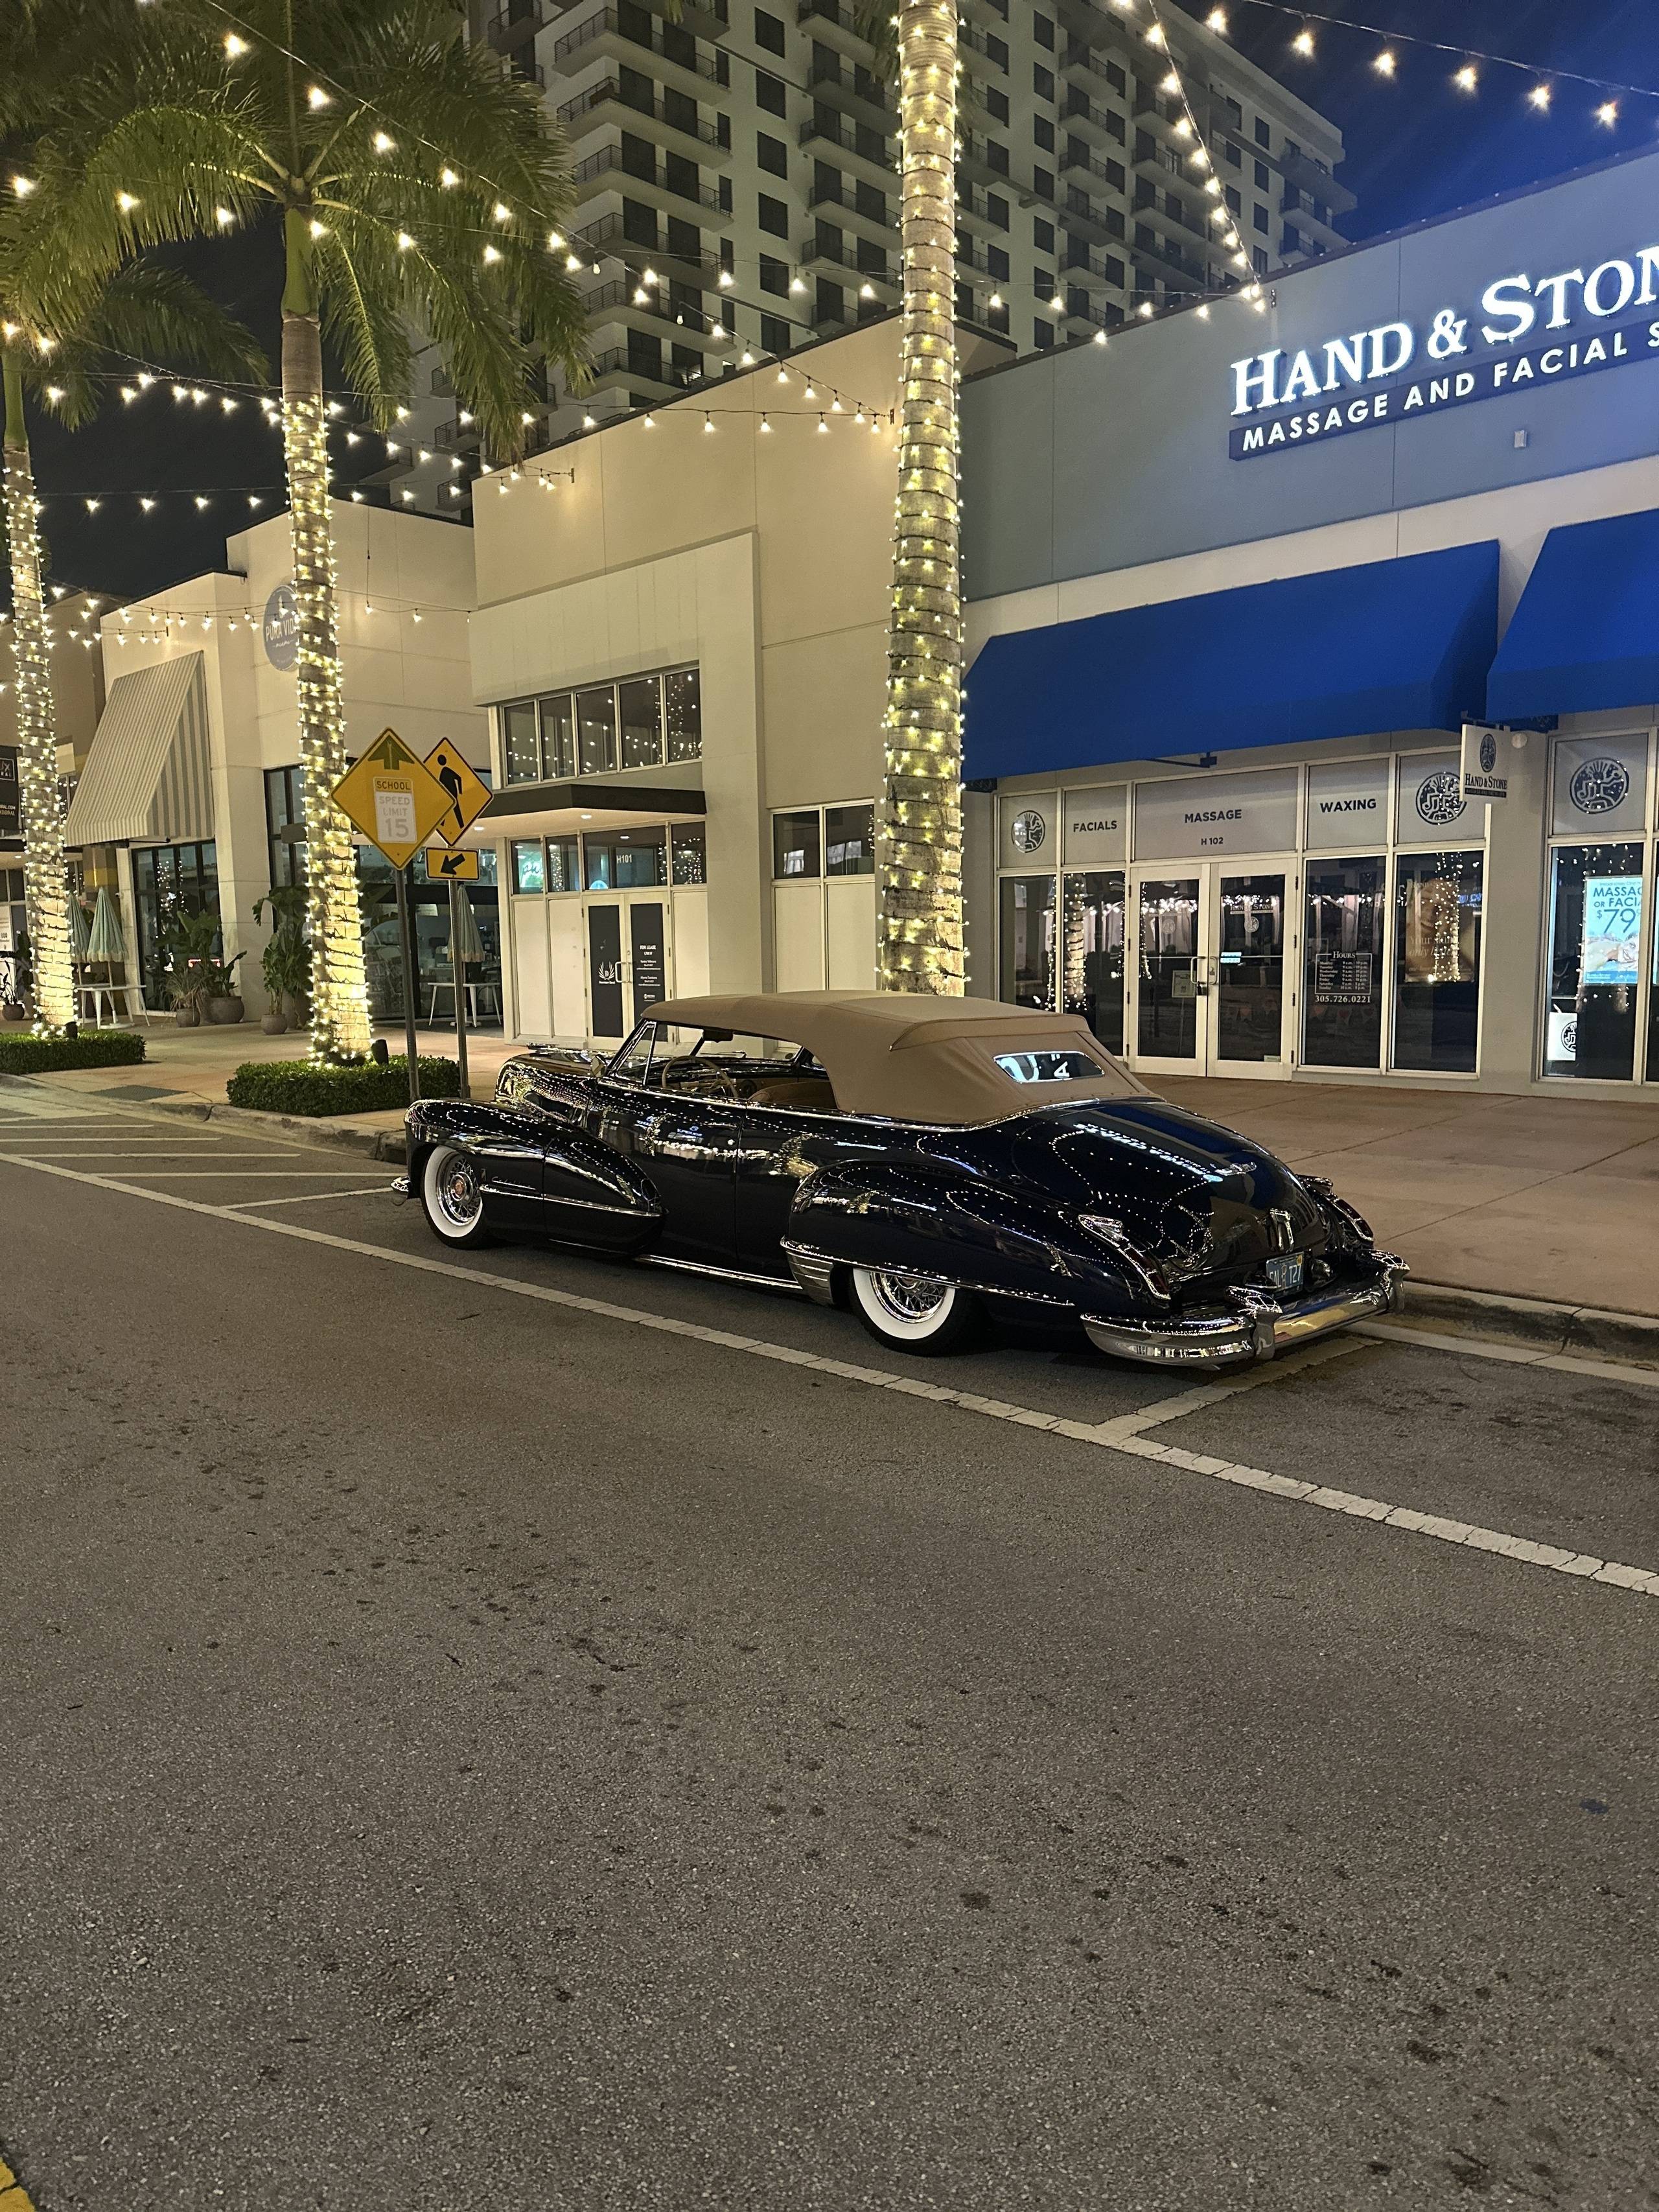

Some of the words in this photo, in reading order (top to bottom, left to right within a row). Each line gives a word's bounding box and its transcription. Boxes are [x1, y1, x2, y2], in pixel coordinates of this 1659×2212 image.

[1229, 321, 1414, 416] HAND
[1427, 309, 1468, 358] &
[1242, 393, 1387, 451] MASSAGE
[1404, 372, 1475, 410] AND
[1493, 332, 1627, 387] FACIAL
[283, 618, 297, 636] VID
[376, 780, 411, 791] SCHOOL
[1465, 773, 1483, 787] HAND
[1488, 775, 1508, 789] STONE
[378, 796, 410, 805] SPEED
[1320, 798, 1376, 813] WAXING
[382, 808, 408, 816] LIMIT
[1184, 808, 1242, 824] MASSAGE
[385, 819, 409, 838] 15
[1073, 820, 1117, 833] FACIALS
[1209, 837, 1224, 845] 102
[616, 854, 632, 864] H101
[1315, 995, 1371, 1003] 305.726.0221
[1288, 1264, 1302, 1285] T27
